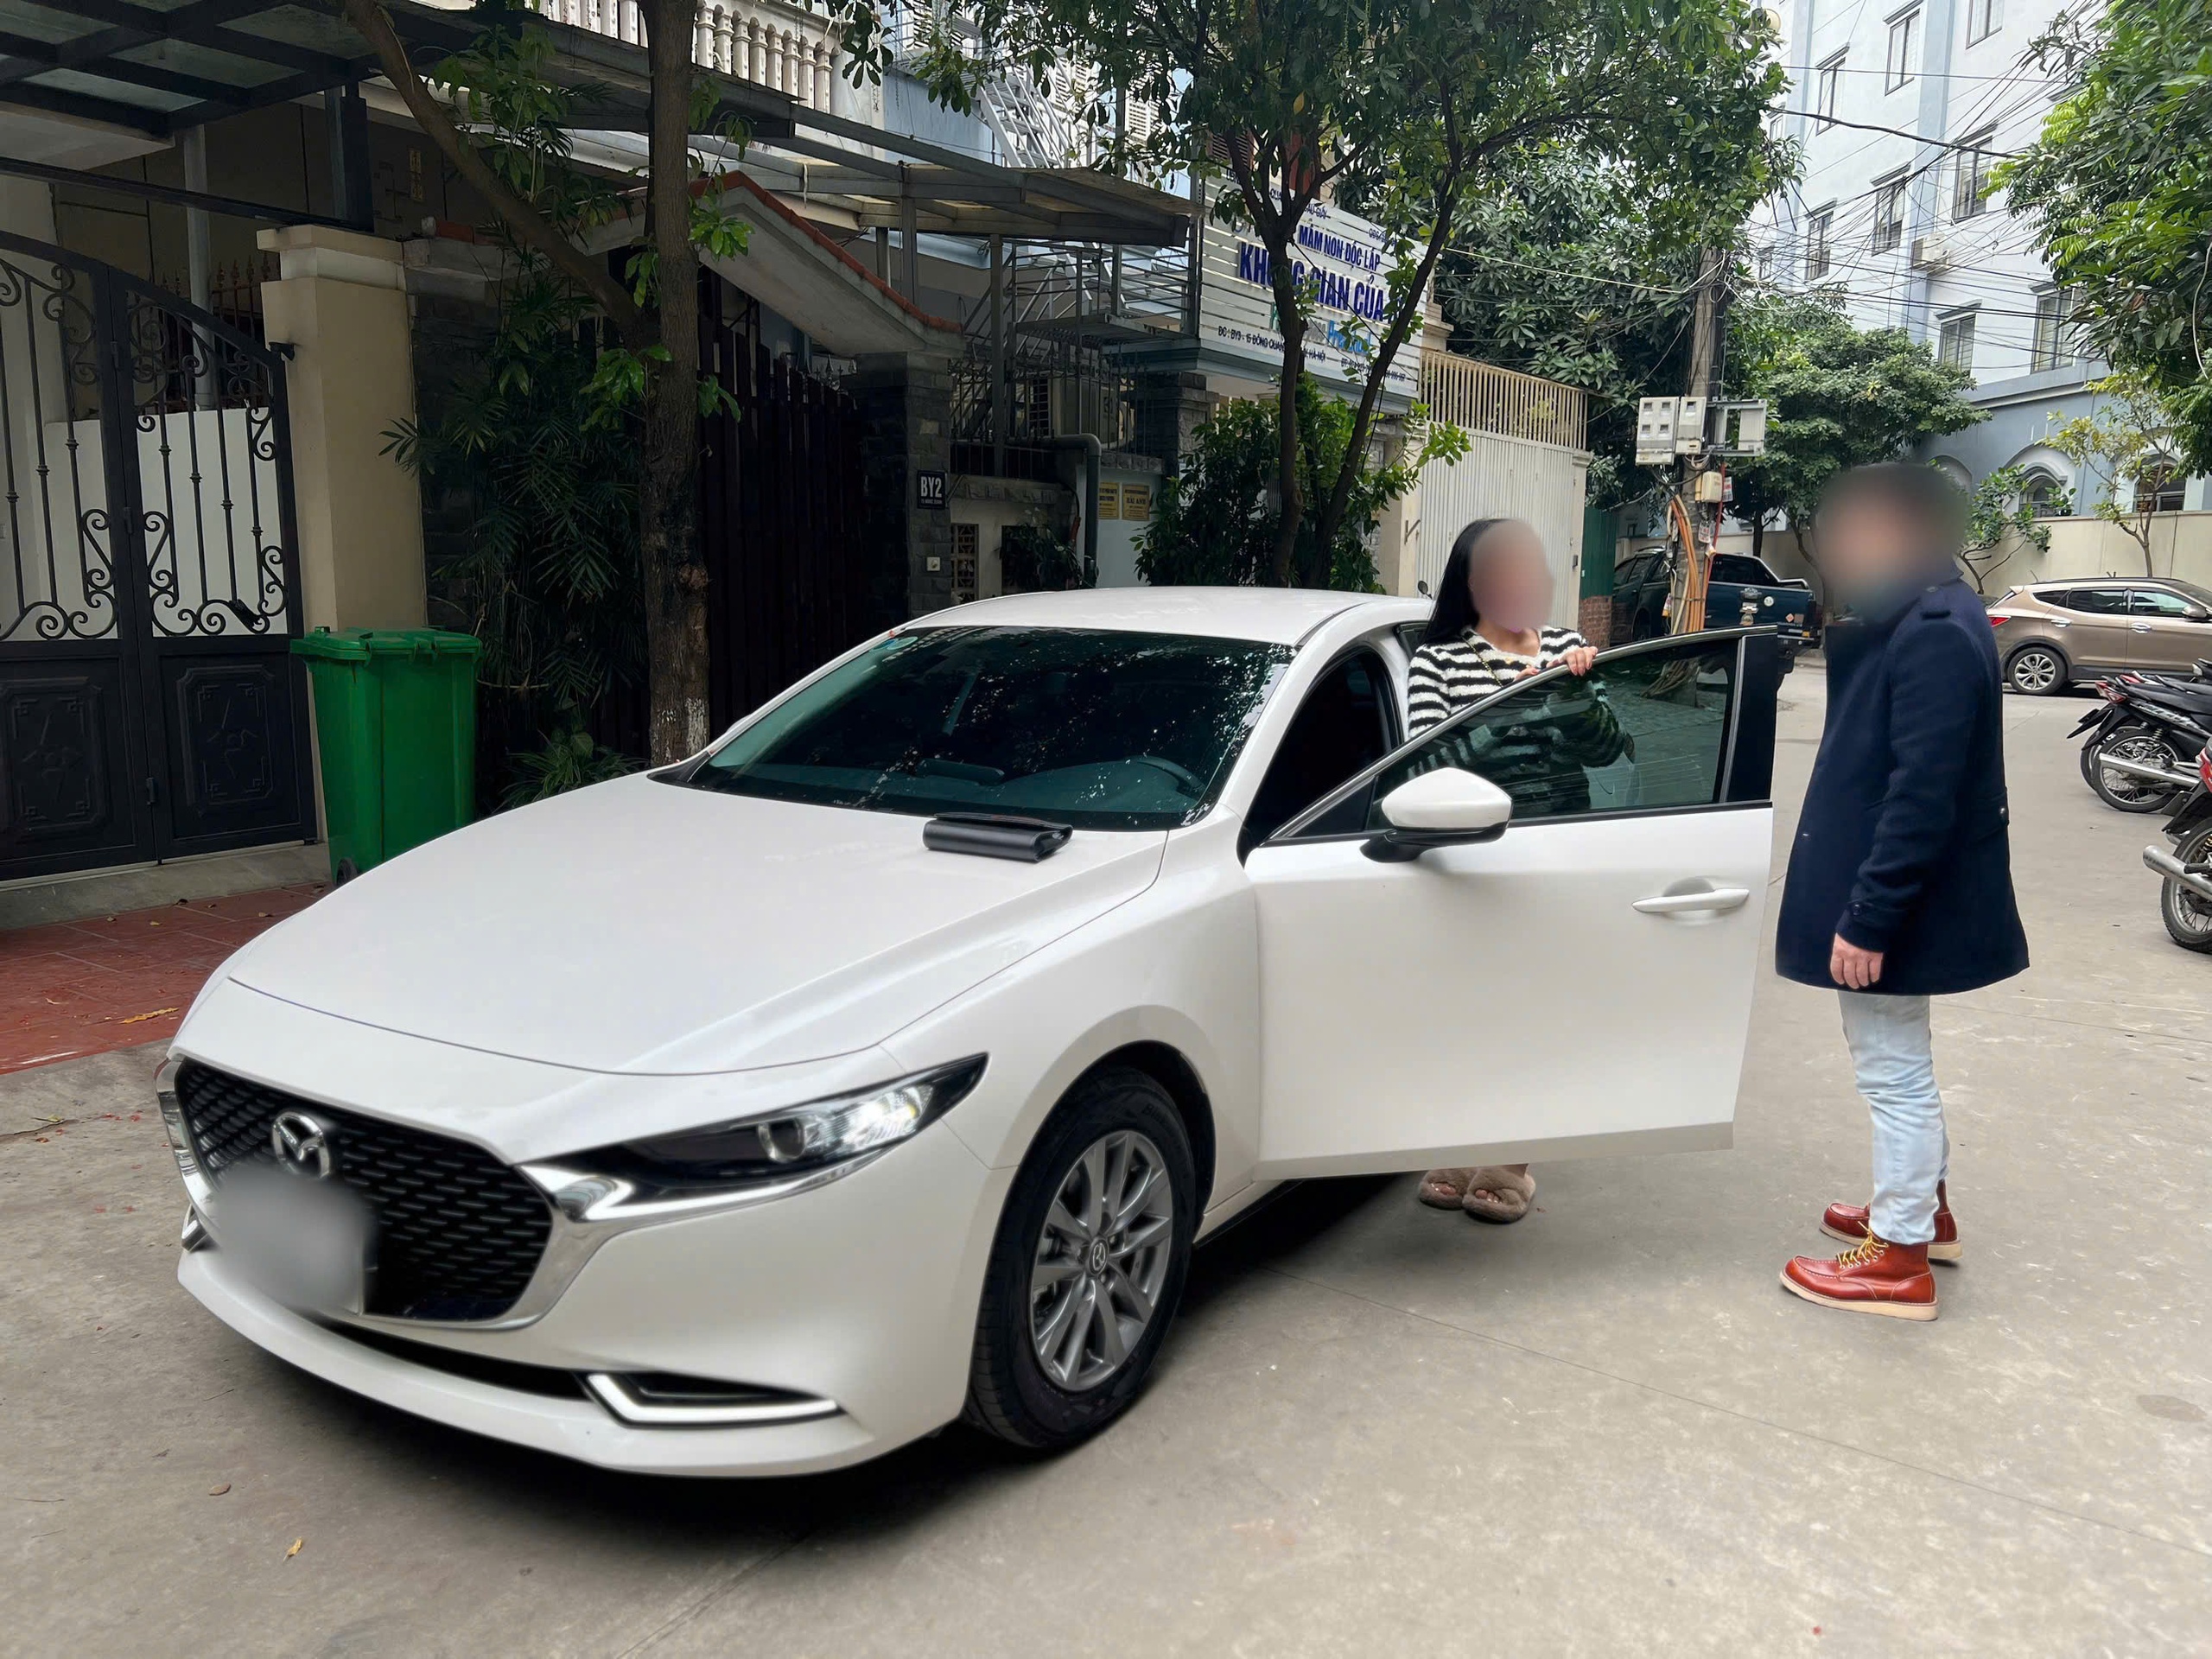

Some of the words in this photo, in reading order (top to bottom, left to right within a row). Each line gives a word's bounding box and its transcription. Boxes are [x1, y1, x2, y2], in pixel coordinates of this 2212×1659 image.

[1324, 233, 1344, 260] NON
[1344, 239, 1363, 271] ĐỘC
[1240, 241, 1306, 296] KHG
[1309, 267, 1351, 311] GIAN
[1354, 273, 1384, 322] CỦA
[920, 476, 943, 498] BY2
